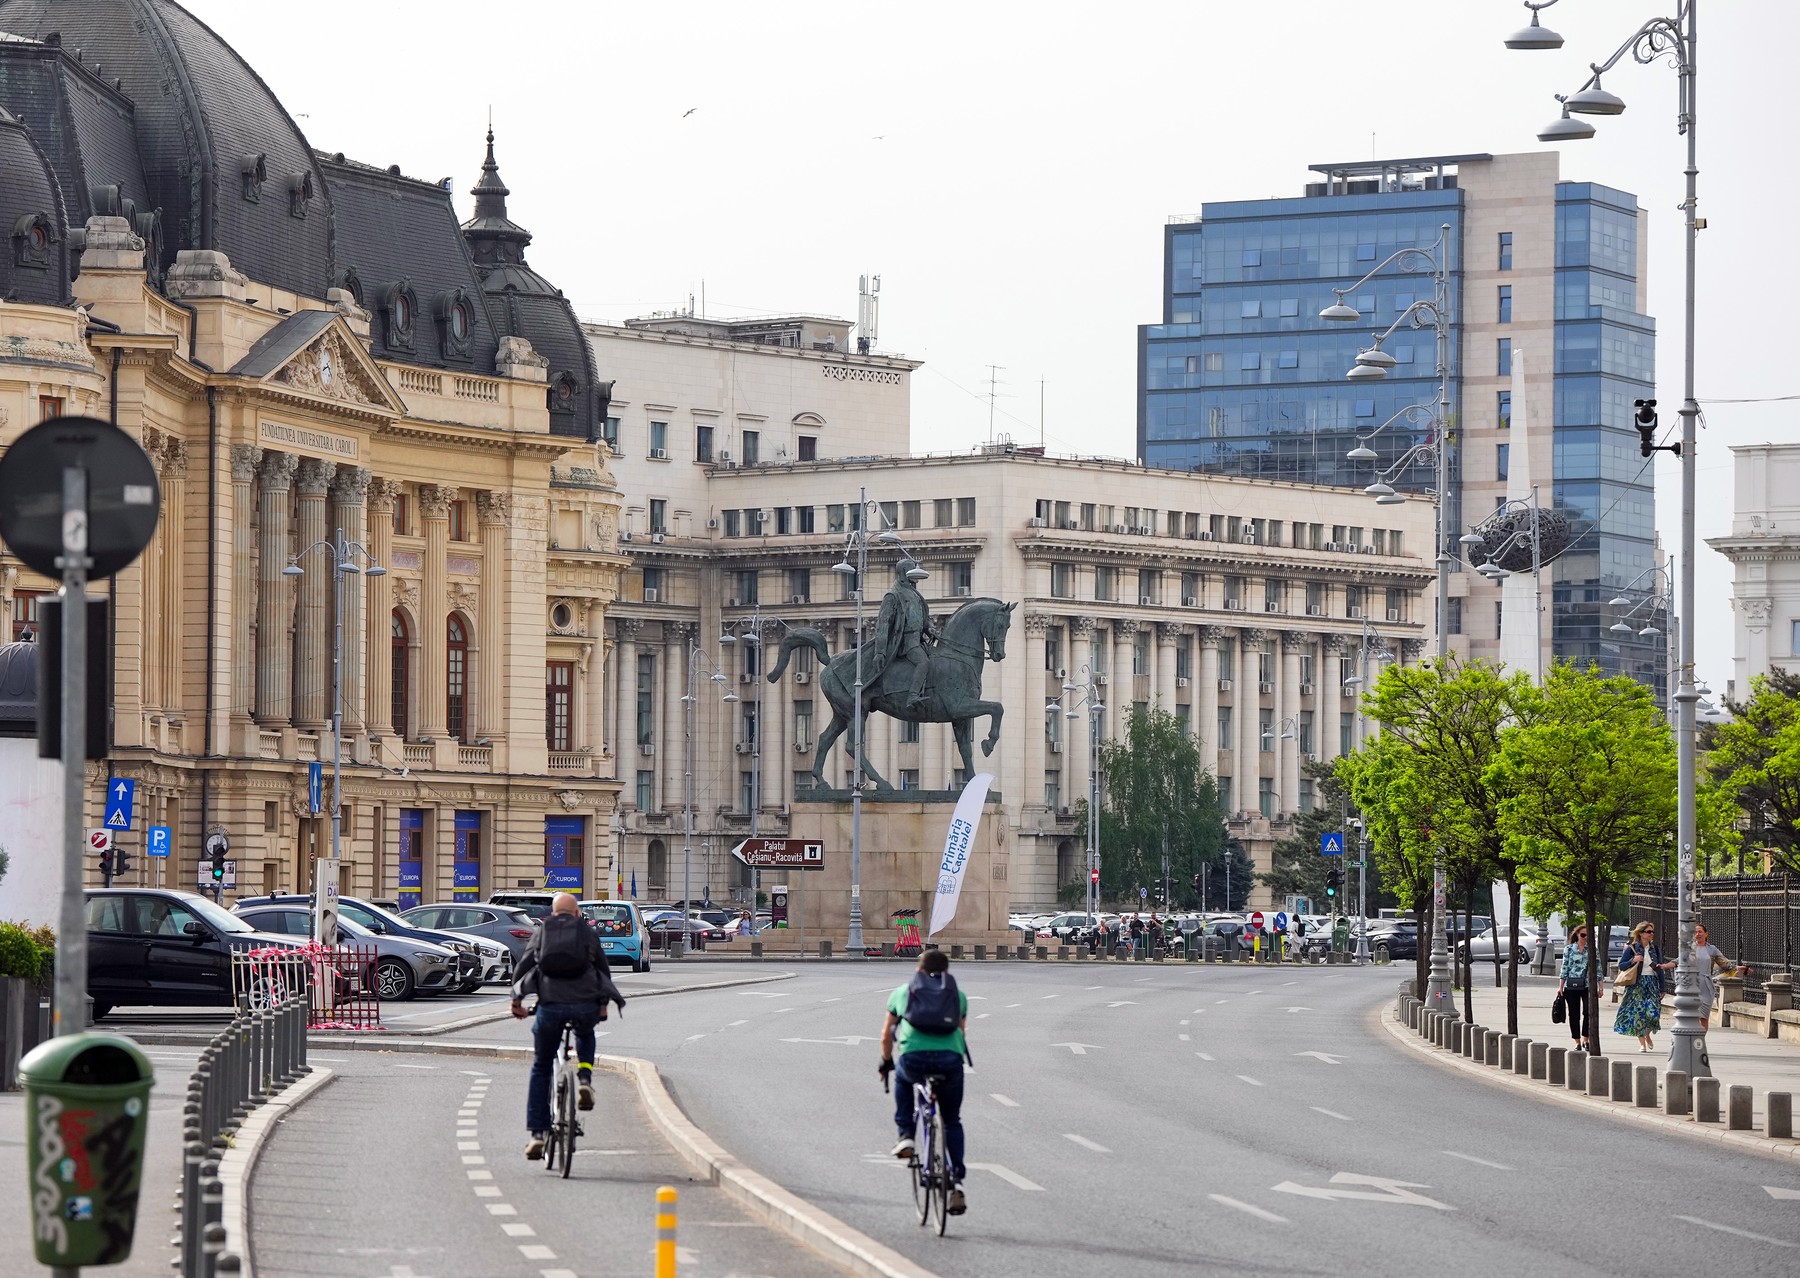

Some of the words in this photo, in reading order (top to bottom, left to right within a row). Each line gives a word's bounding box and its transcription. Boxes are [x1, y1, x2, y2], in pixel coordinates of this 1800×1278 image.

[297, 430, 333, 450] UNIVERSITARA
[335, 438, 351, 454] CAROL
[153, 829, 166, 847] P
[764, 840, 786, 850] Palatul
[941, 818, 963, 872] Primăria
[951, 821, 972, 874] Capitalei
